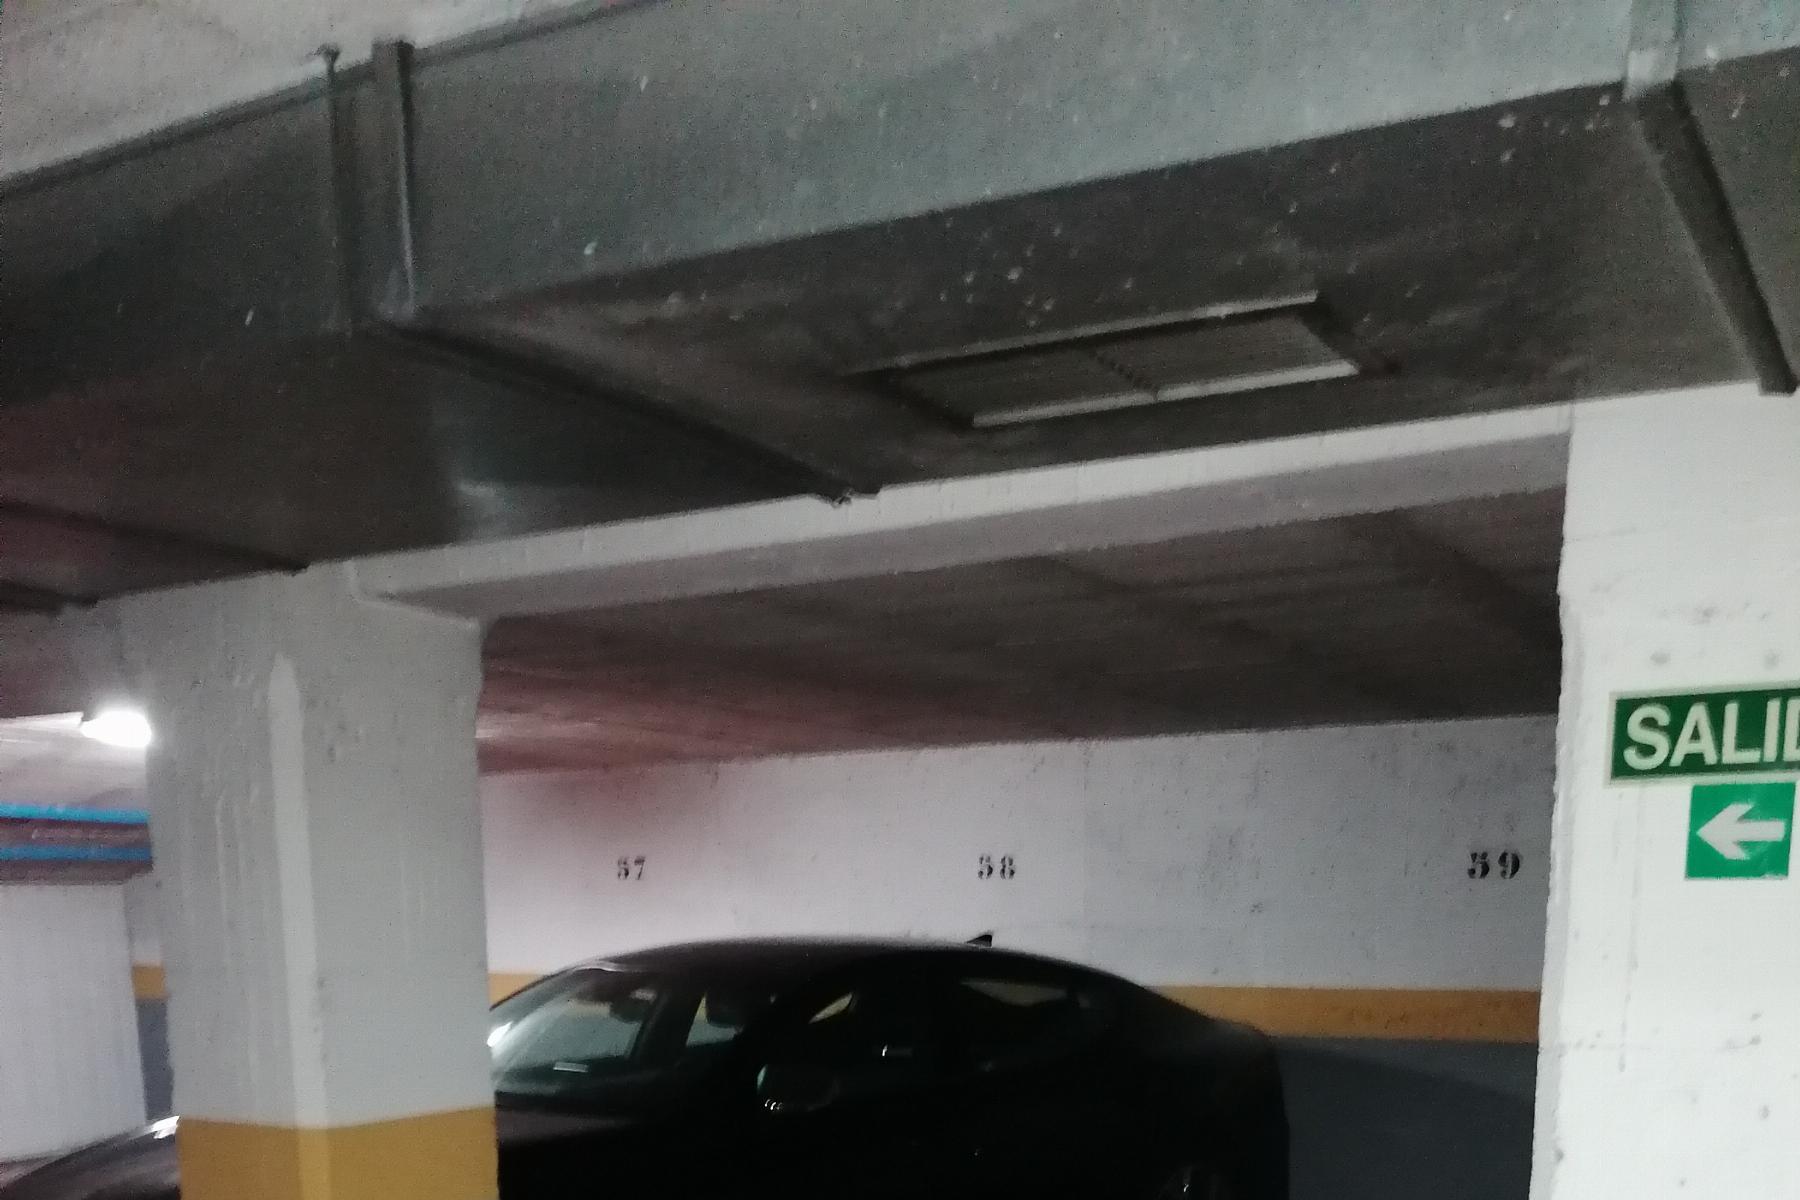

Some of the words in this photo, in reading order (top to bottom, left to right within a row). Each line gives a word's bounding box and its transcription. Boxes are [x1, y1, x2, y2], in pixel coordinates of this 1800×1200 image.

[617, 856, 646, 880] 57
[978, 855, 1015, 880] 58
[1467, 851, 1520, 879] 59
